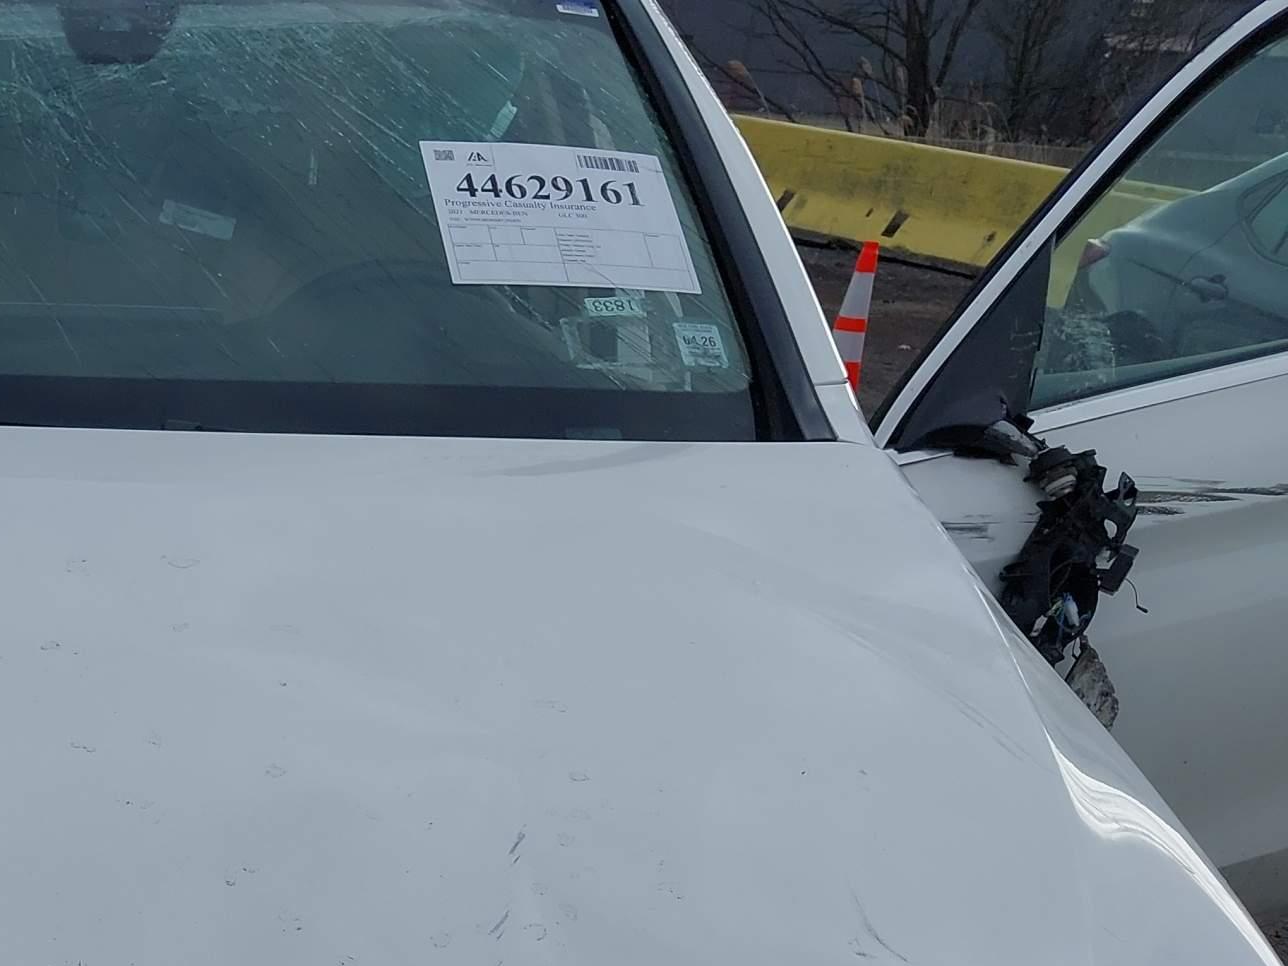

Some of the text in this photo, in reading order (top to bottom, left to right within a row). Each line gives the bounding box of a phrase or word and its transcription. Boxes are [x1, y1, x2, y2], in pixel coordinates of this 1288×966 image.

[456, 172, 644, 206] 44629161
[444, 198, 597, 212] Progressive Casualty Insurance
[592, 299, 635, 312] 1833
[701, 335, 717, 348] 26
